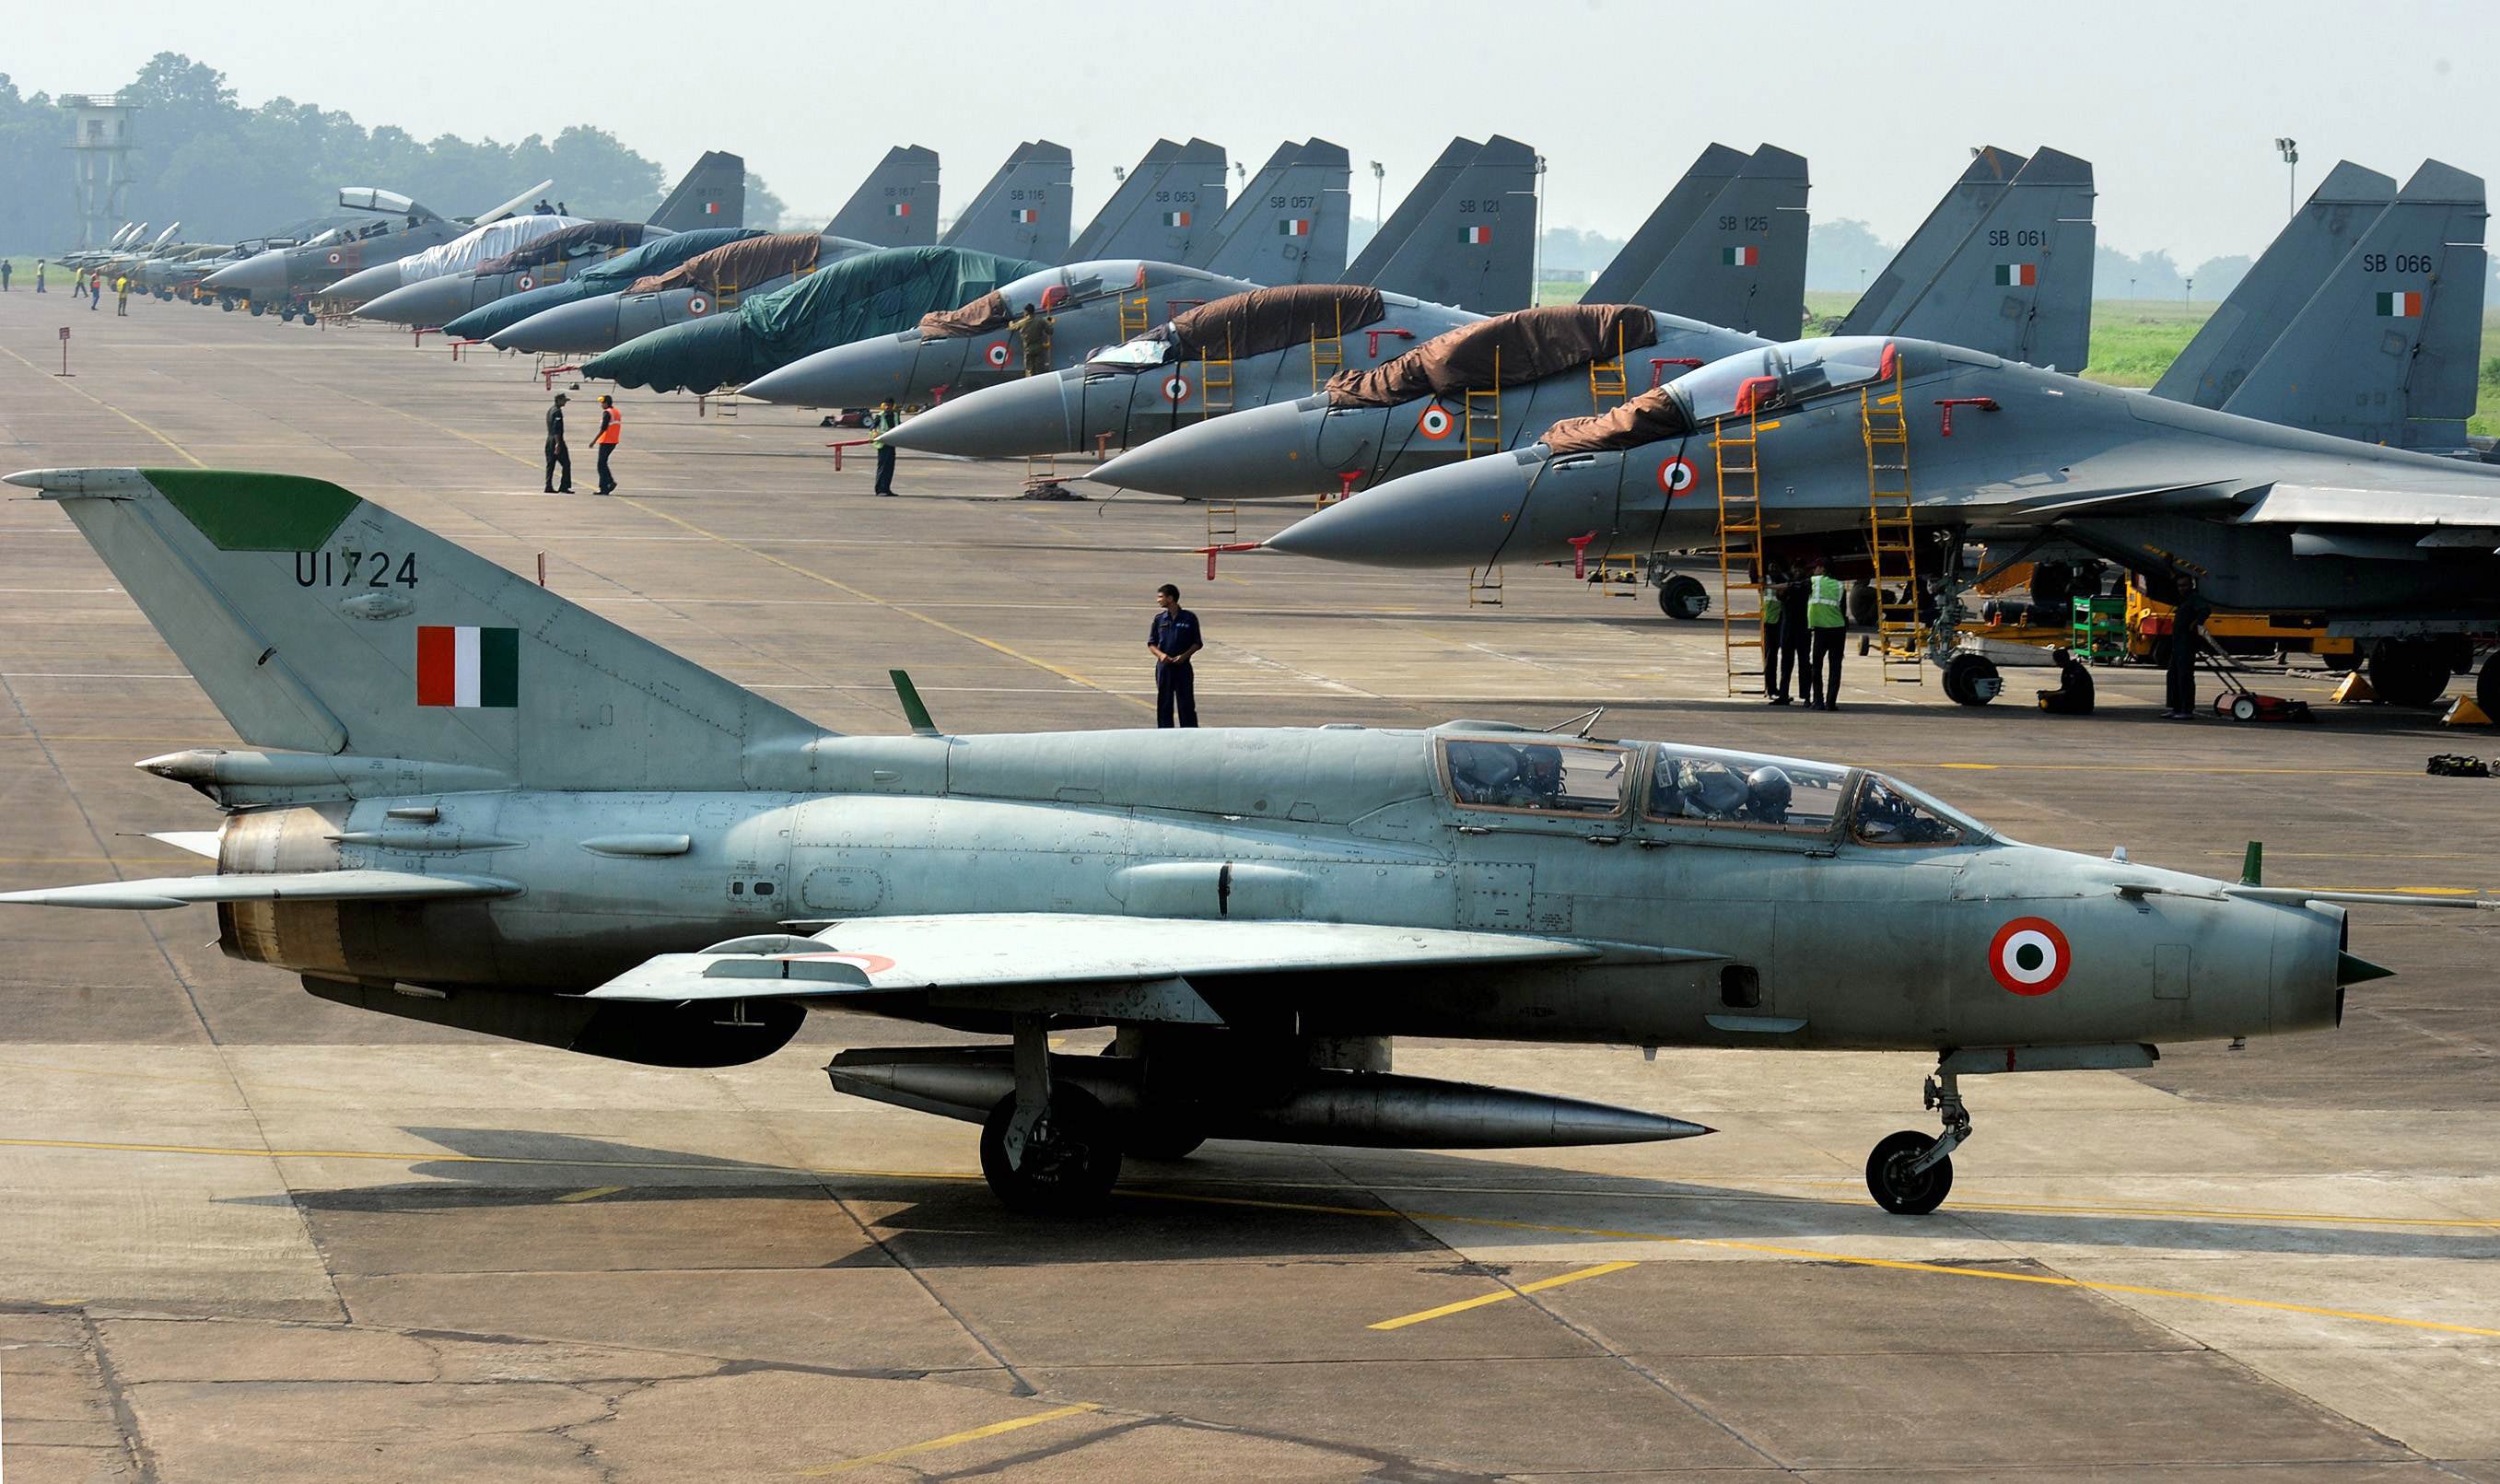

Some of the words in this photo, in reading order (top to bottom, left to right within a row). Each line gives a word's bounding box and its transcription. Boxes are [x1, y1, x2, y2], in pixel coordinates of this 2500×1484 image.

[1011, 190, 1023, 200] SB
[1028, 190, 1045, 200] 116
[1156, 191, 1170, 202] SB
[1174, 191, 1196, 202] 063
[1270, 196, 1286, 208] SB
[1291, 196, 1314, 208] 057
[1459, 200, 1476, 213] SB
[1483, 200, 1500, 213] 121
[1719, 216, 1737, 230] SB
[1745, 216, 1768, 231] 125
[1989, 229, 2010, 247] SB
[2017, 229, 2046, 247] 061
[2363, 254, 2388, 273] SB
[2395, 254, 2432, 274] 066
